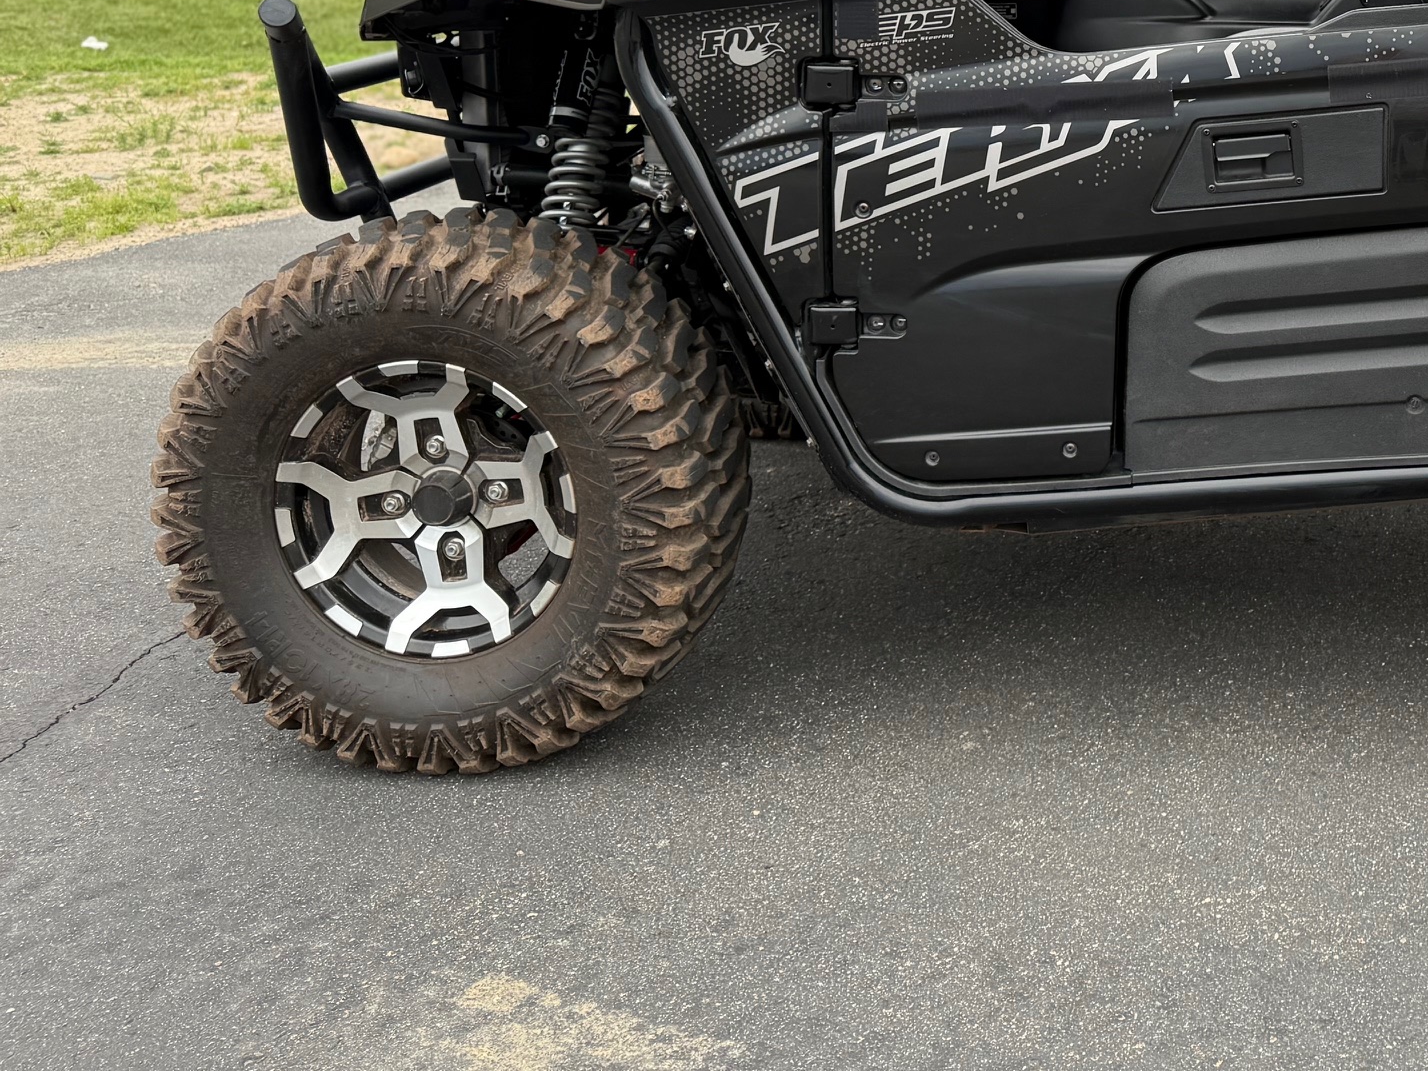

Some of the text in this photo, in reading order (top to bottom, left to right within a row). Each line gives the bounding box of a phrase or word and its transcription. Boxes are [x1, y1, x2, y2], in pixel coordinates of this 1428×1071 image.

[698, 22, 786, 67] FOX
[859, 32, 955, 49] Electric Power Steering
[577, 47, 600, 107] FOX
